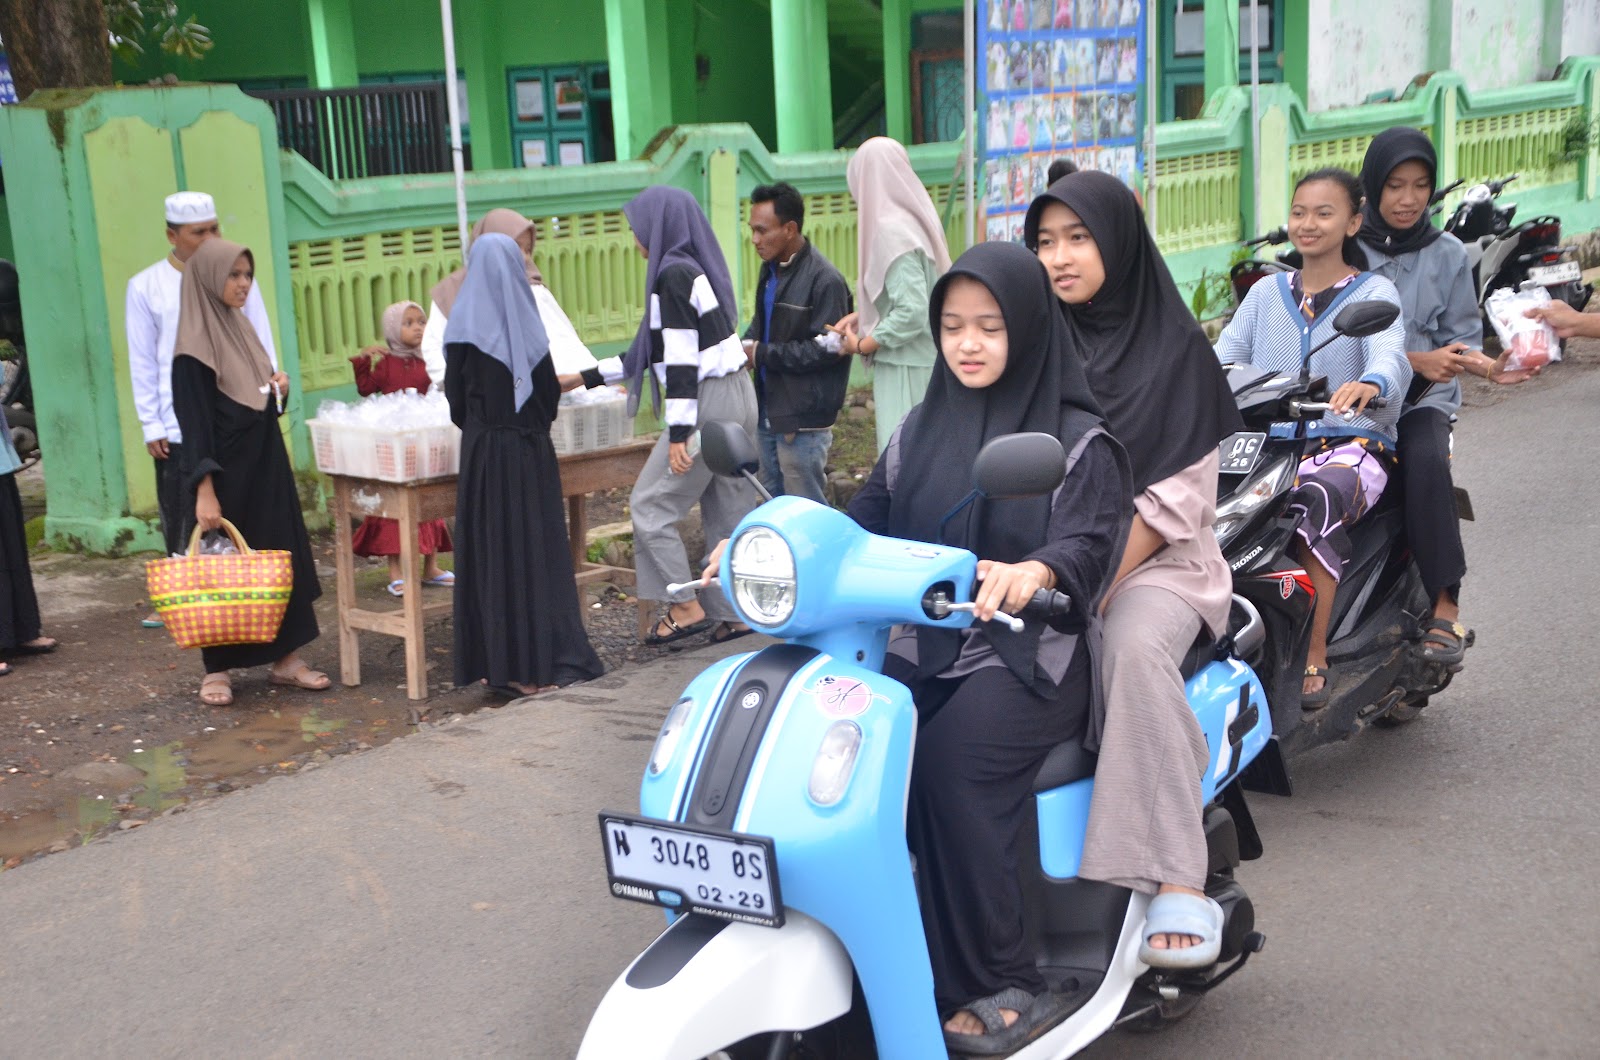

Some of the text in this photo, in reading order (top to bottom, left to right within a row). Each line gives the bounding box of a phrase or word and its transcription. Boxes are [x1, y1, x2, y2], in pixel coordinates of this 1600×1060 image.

[1231, 545, 1264, 571] HONDA
[651, 836, 710, 871] 3048
[621, 883, 655, 901] YAMAHA
